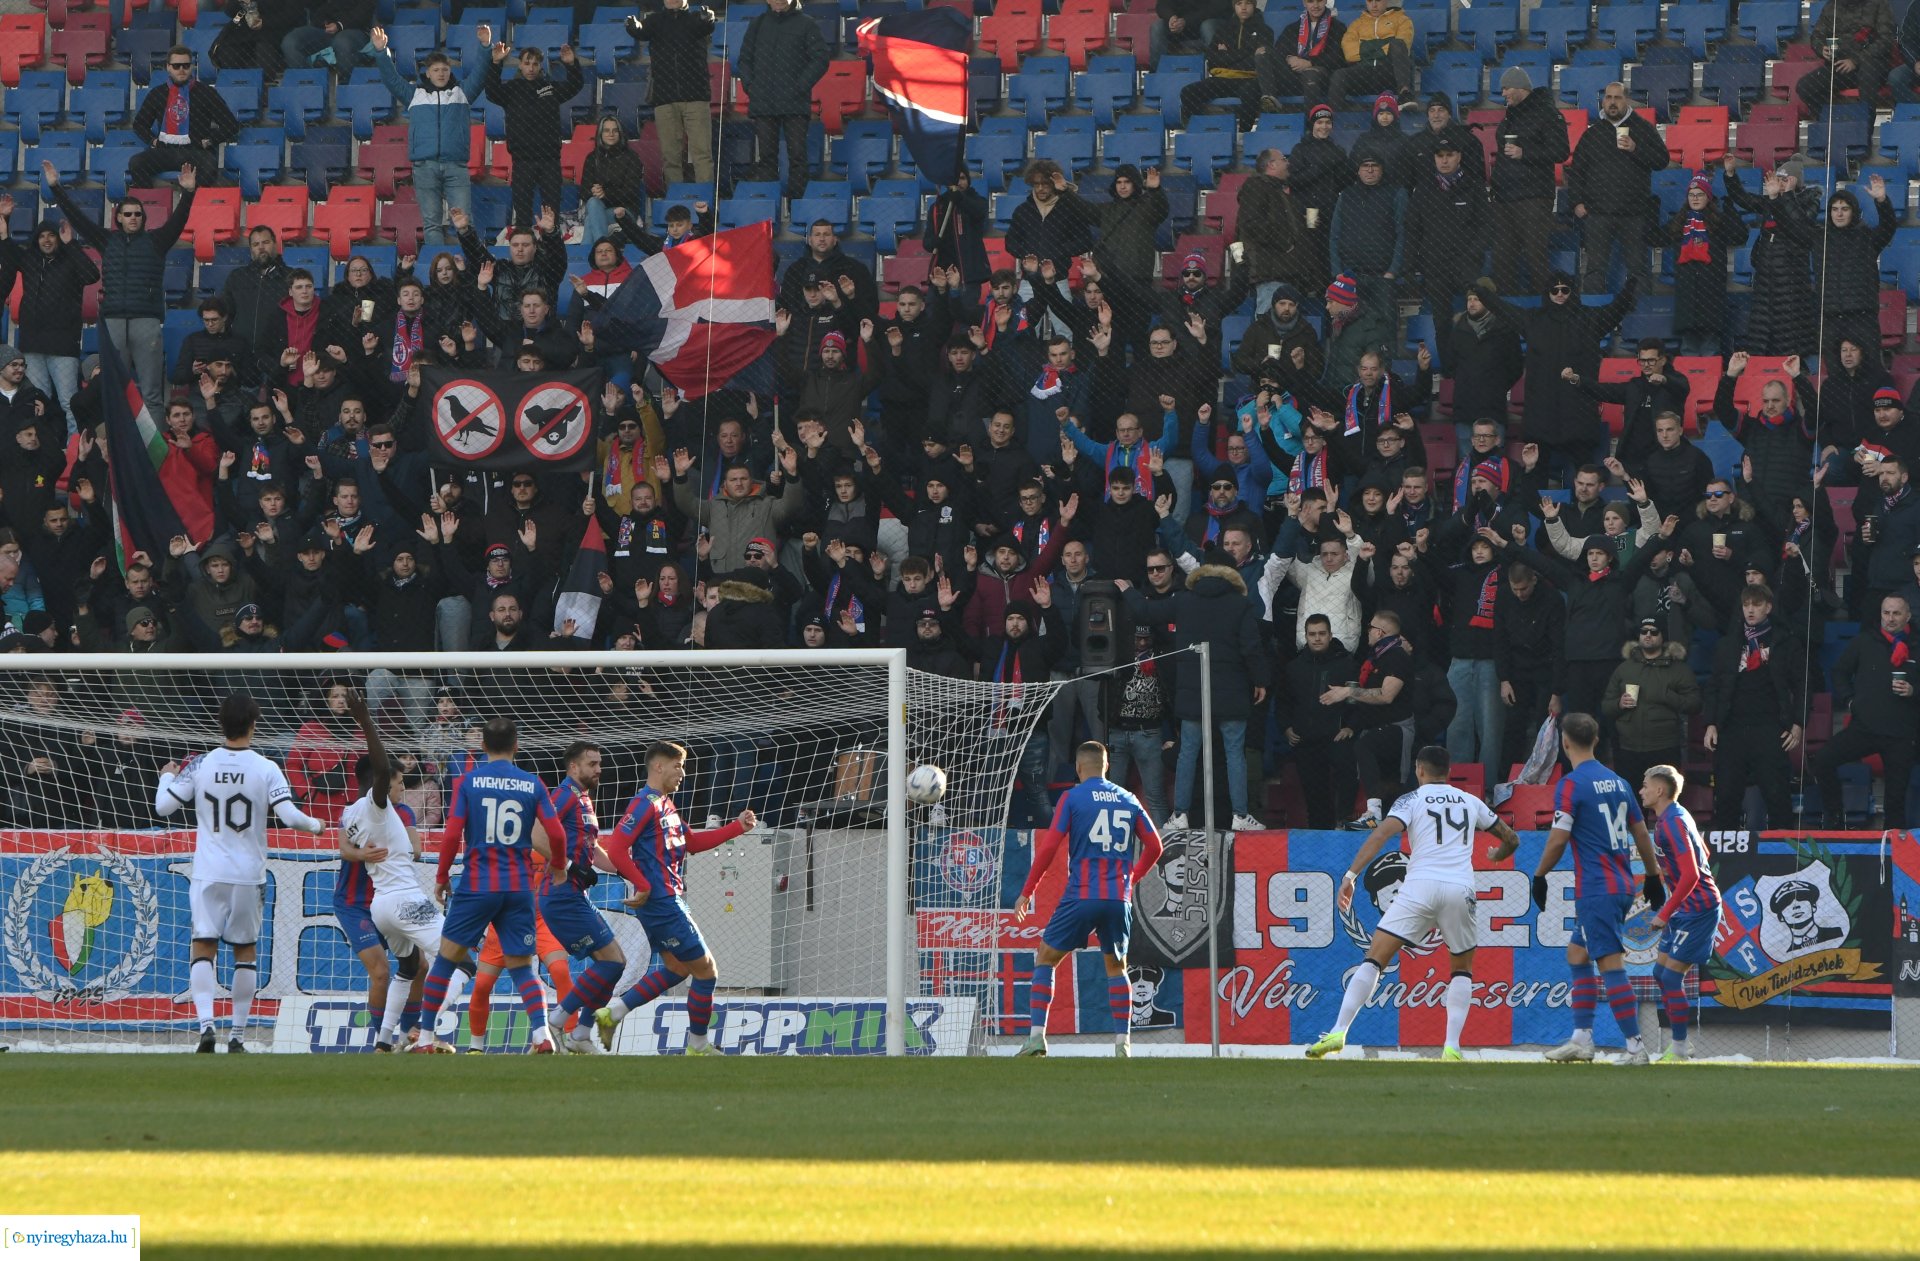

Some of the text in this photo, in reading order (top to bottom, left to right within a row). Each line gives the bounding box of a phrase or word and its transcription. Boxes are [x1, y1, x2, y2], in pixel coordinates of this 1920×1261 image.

[214, 772, 244, 784] LEVI
[1593, 780, 1616, 794] NAGY
[204, 791, 253, 833] 10
[1425, 795, 1466, 804] GOLLA
[481, 797, 523, 845] 16
[1088, 808, 1132, 853] 45
[1427, 807, 1470, 846] 14
[1598, 801, 1628, 850] 14
[1735, 887, 1758, 919] S
[1737, 940, 1758, 974] F
[1218, 959, 1319, 1019] Vén
